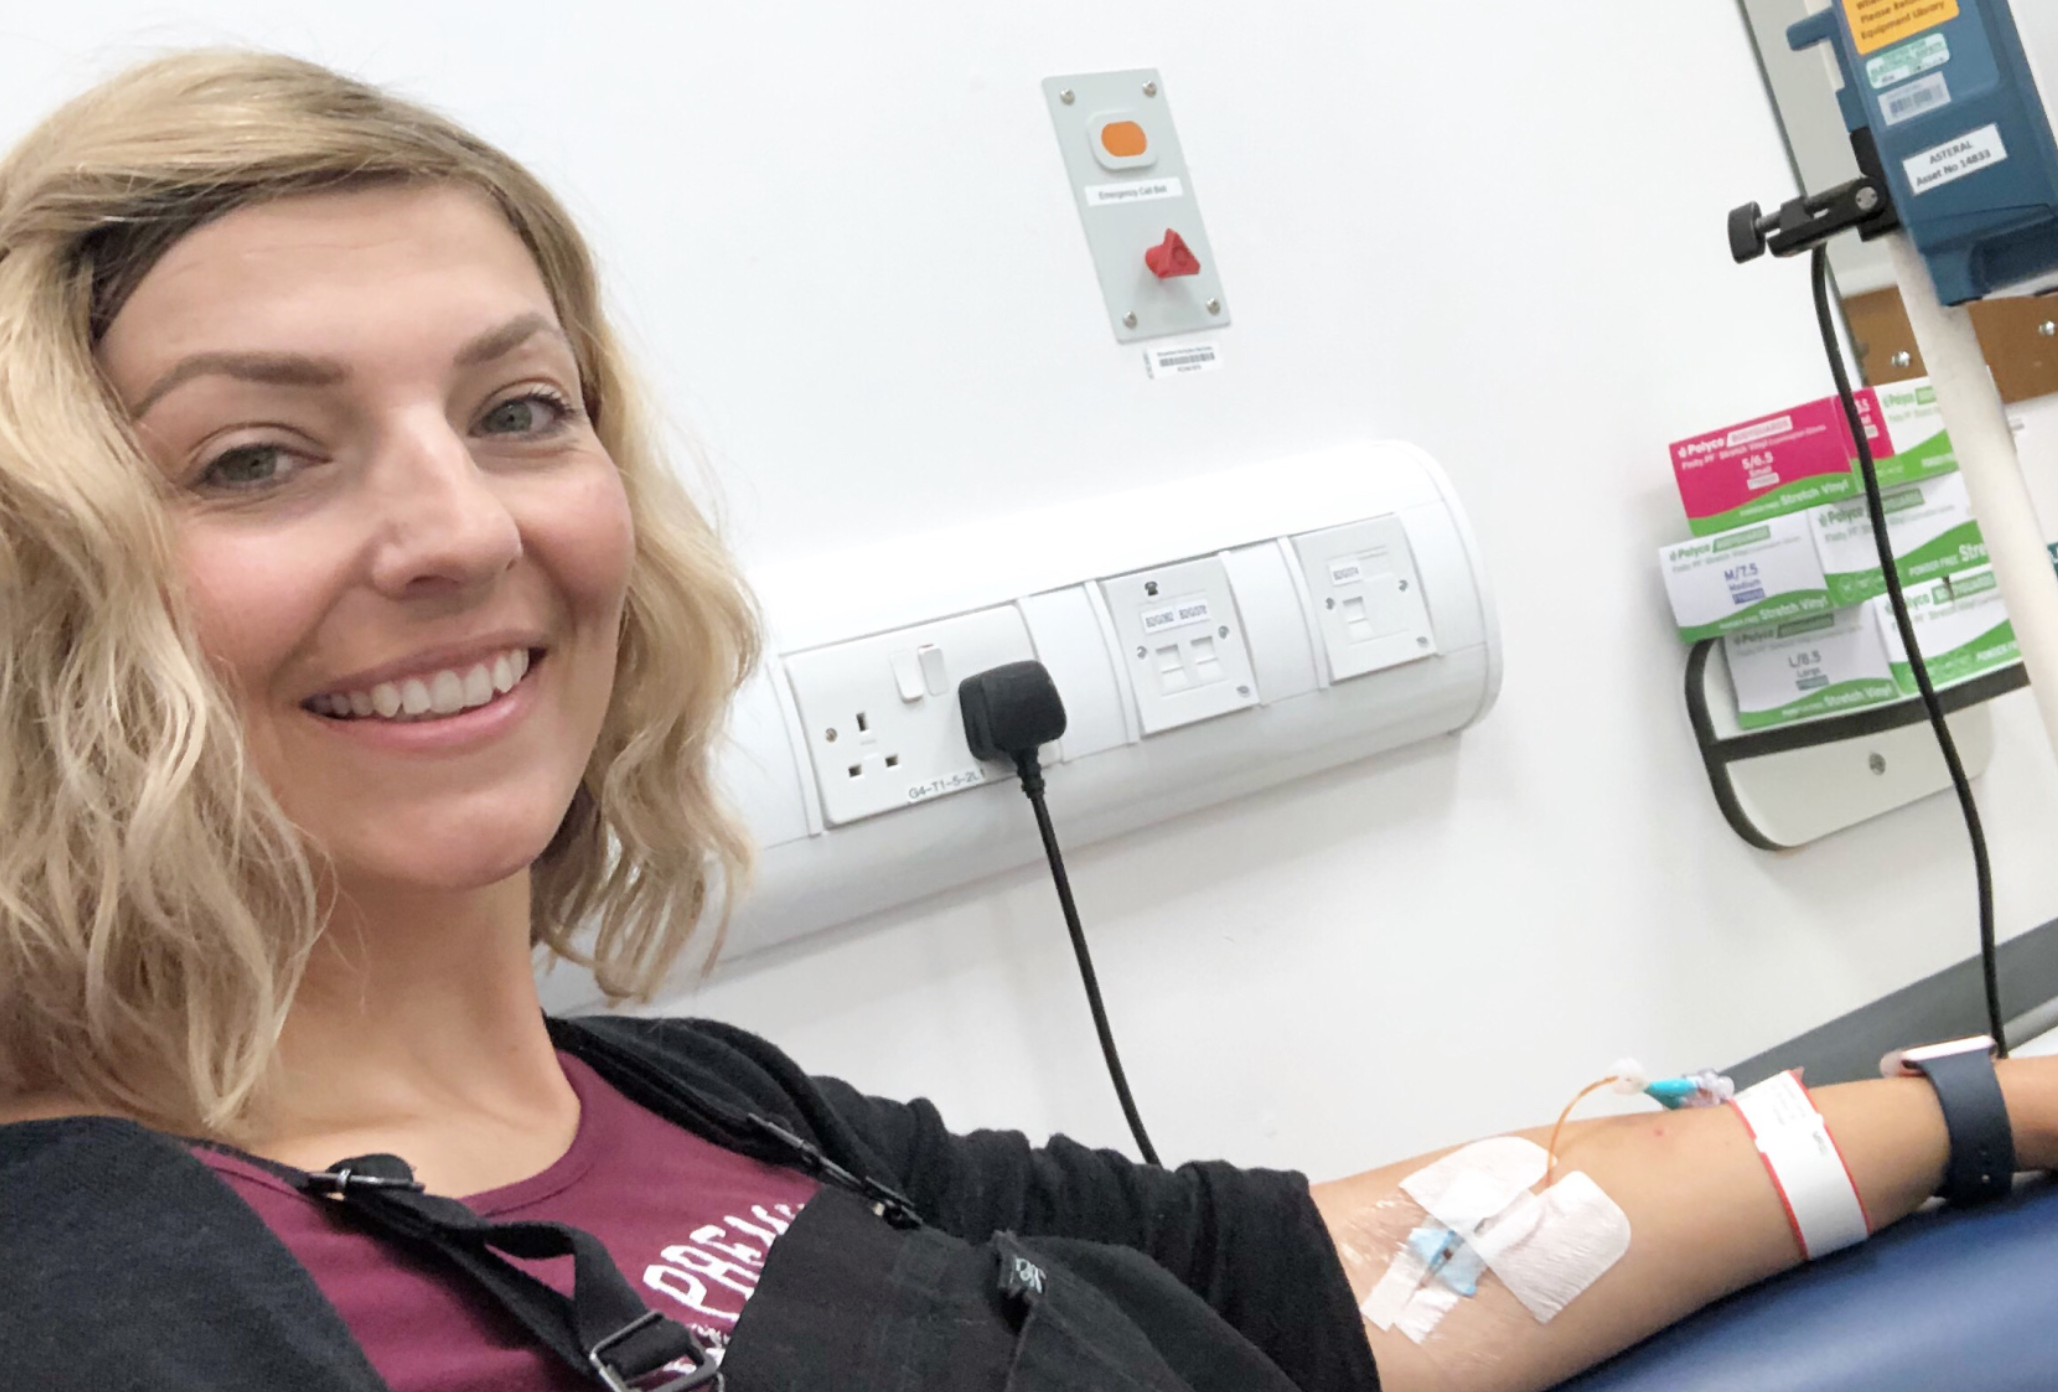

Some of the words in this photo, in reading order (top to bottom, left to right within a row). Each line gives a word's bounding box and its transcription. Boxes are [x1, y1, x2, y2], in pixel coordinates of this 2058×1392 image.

[1860, 7, 1891, 24] Please
[1860, 13, 1911, 40] Equipment
[1912, 1, 1945, 19] Library
[1929, 140, 1974, 165] ASTERAL
[1916, 169, 1942, 187] Asset
[1943, 164, 1959, 175] No
[1959, 149, 1992, 168] 14833
[1687, 437, 1725, 456] Polyco
[1779, 488, 1820, 506] Stretch
[1820, 478, 1849, 495] Vinyl
[1828, 506, 1864, 523] Polyco
[1678, 543, 1711, 559] Polyco
[1958, 542, 1987, 562] Stre
[1724, 562, 1759, 582] M/7.5
[1728, 578, 1762, 592] Medium
[1759, 602, 1799, 620] Stretch
[1799, 594, 1829, 612] Vinyl
